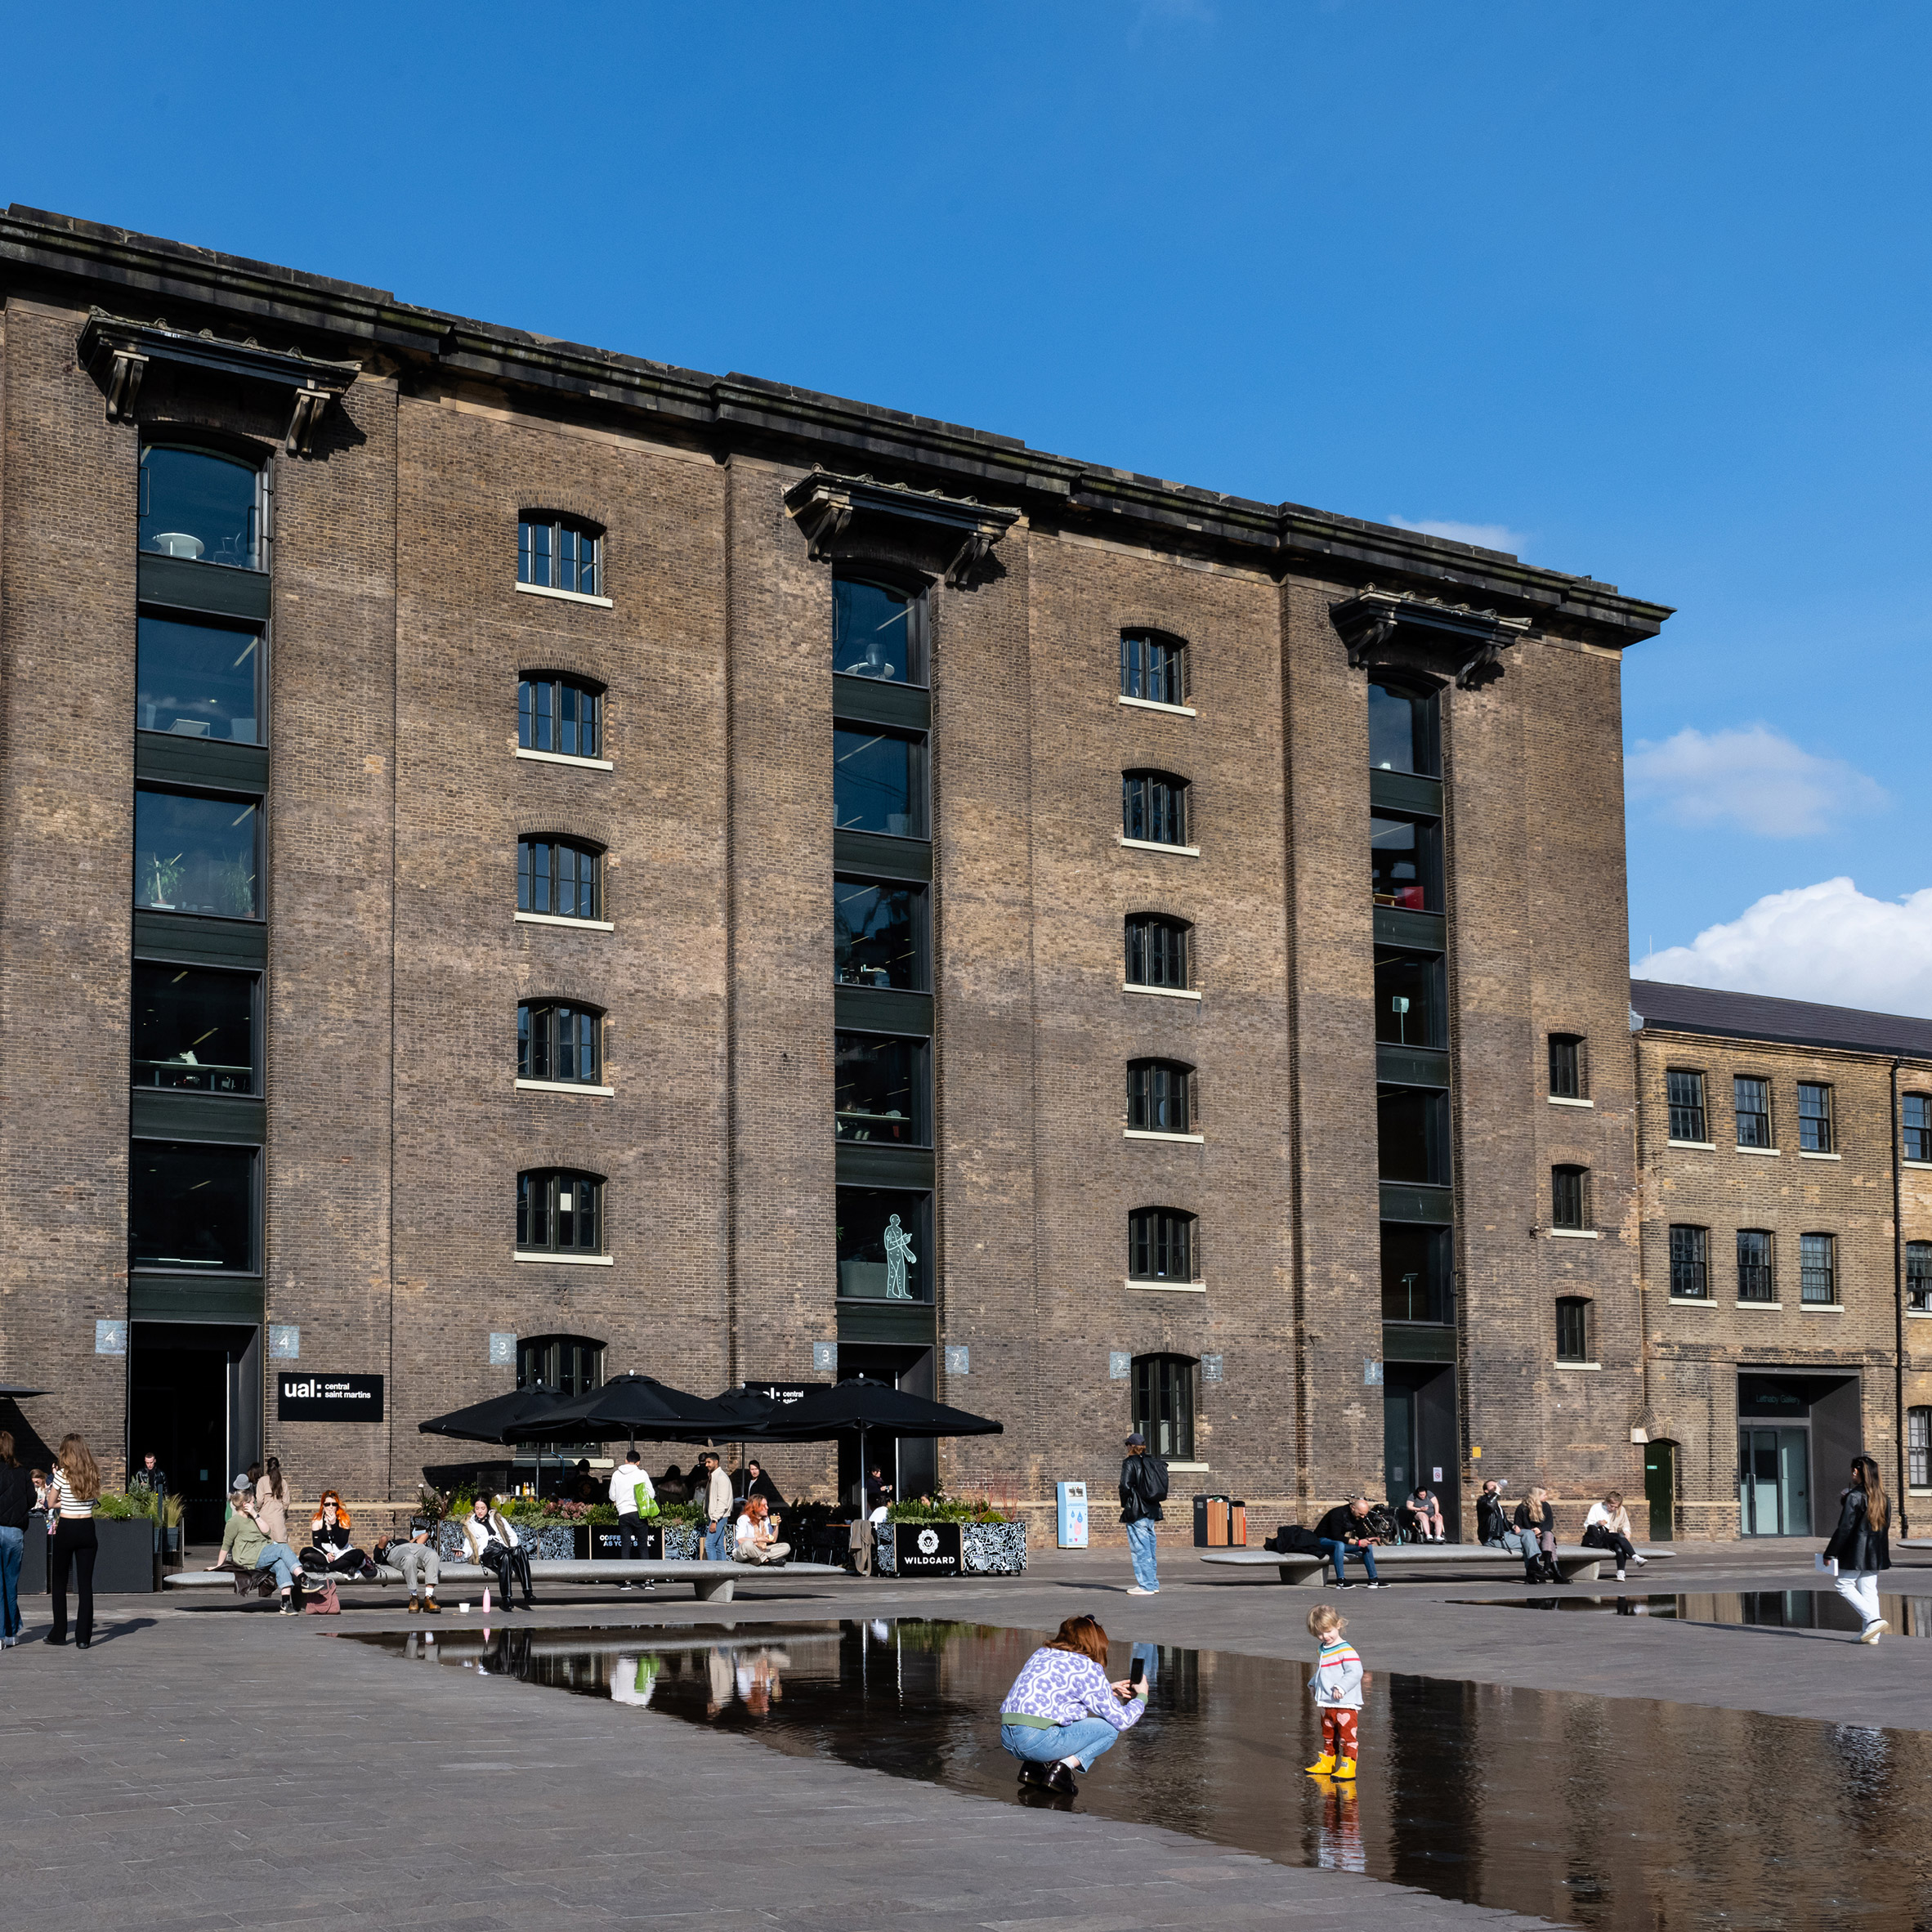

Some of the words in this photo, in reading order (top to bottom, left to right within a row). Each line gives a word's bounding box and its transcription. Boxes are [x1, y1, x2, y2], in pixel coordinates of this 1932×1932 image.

[105, 1327, 116, 1347] 4
[279, 1334, 288, 1348] 4
[499, 1342, 507, 1355] 3
[284, 1380, 322, 1398] ual:
[904, 1556, 955, 1565] WILDCARD
